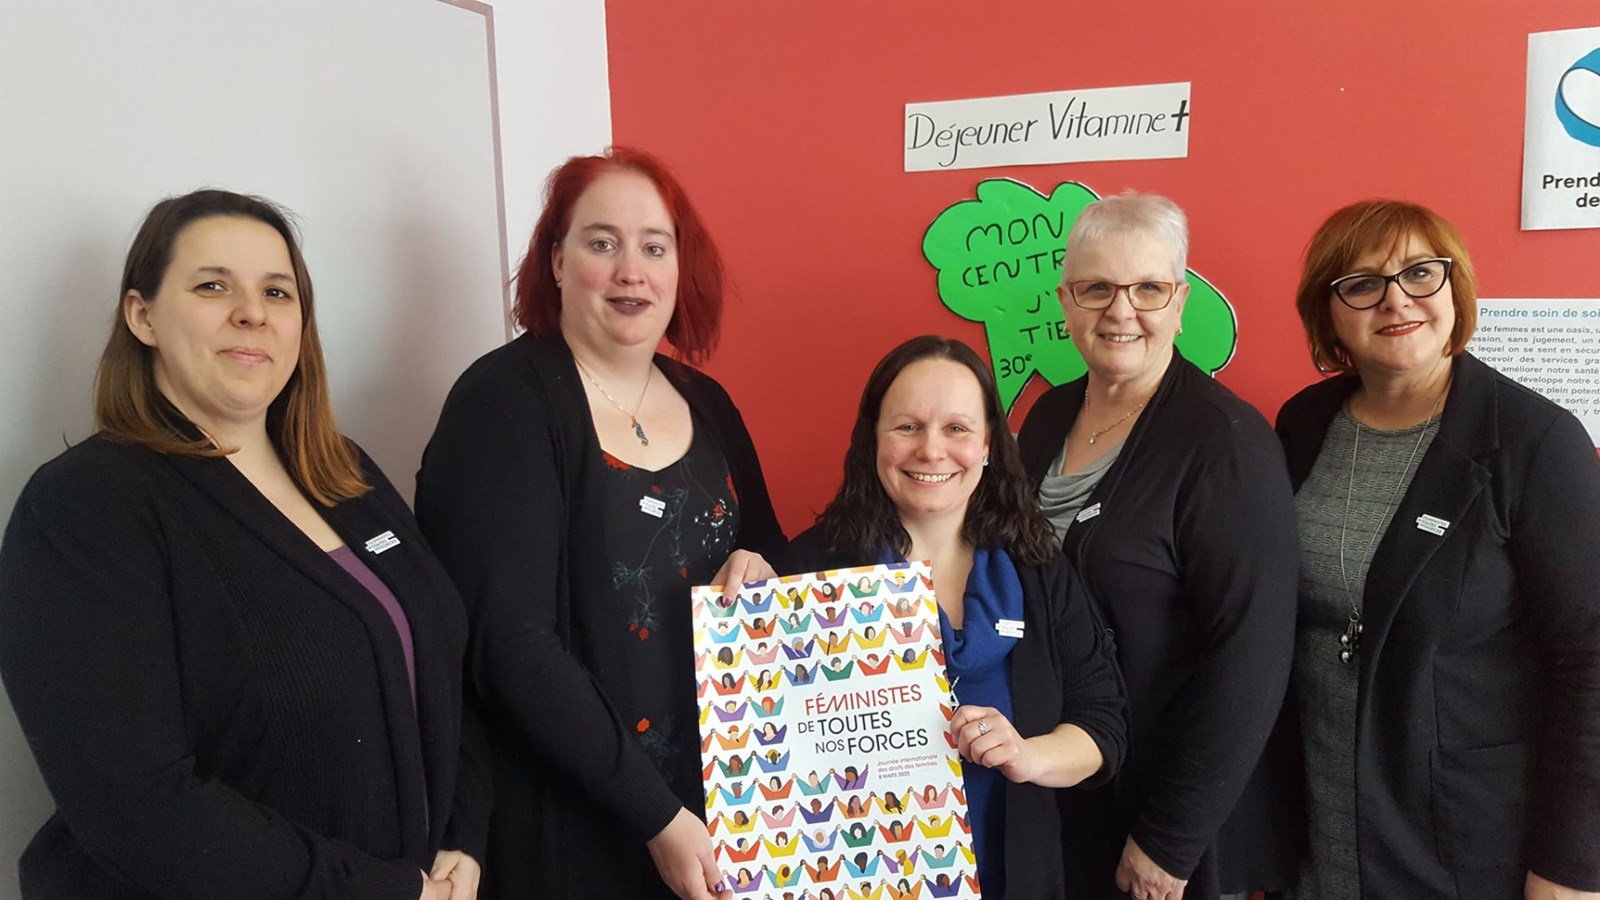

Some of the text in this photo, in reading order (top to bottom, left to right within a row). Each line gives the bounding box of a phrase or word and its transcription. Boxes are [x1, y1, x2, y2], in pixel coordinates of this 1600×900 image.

[907, 113, 1038, 167] Déjeuner
[1543, 172, 1600, 189] Prend
[1576, 193, 1600, 208] de
[966, 211, 1063, 251] MON
[962, 248, 1066, 287] CENTR
[1026, 289, 1057, 314] J'
[1480, 307, 1528, 317] Prendre
[1532, 308, 1558, 317] soin
[1563, 308, 1578, 317] de
[1479, 345, 1505, 353] lequel
[1533, 336, 1577, 344] jugement,
[1517, 376, 1563, 384] développe
[805, 684, 922, 716] FÉMINISTES
[798, 711, 892, 736] DE TOUTES
[815, 728, 928, 755] NOS FORCES
